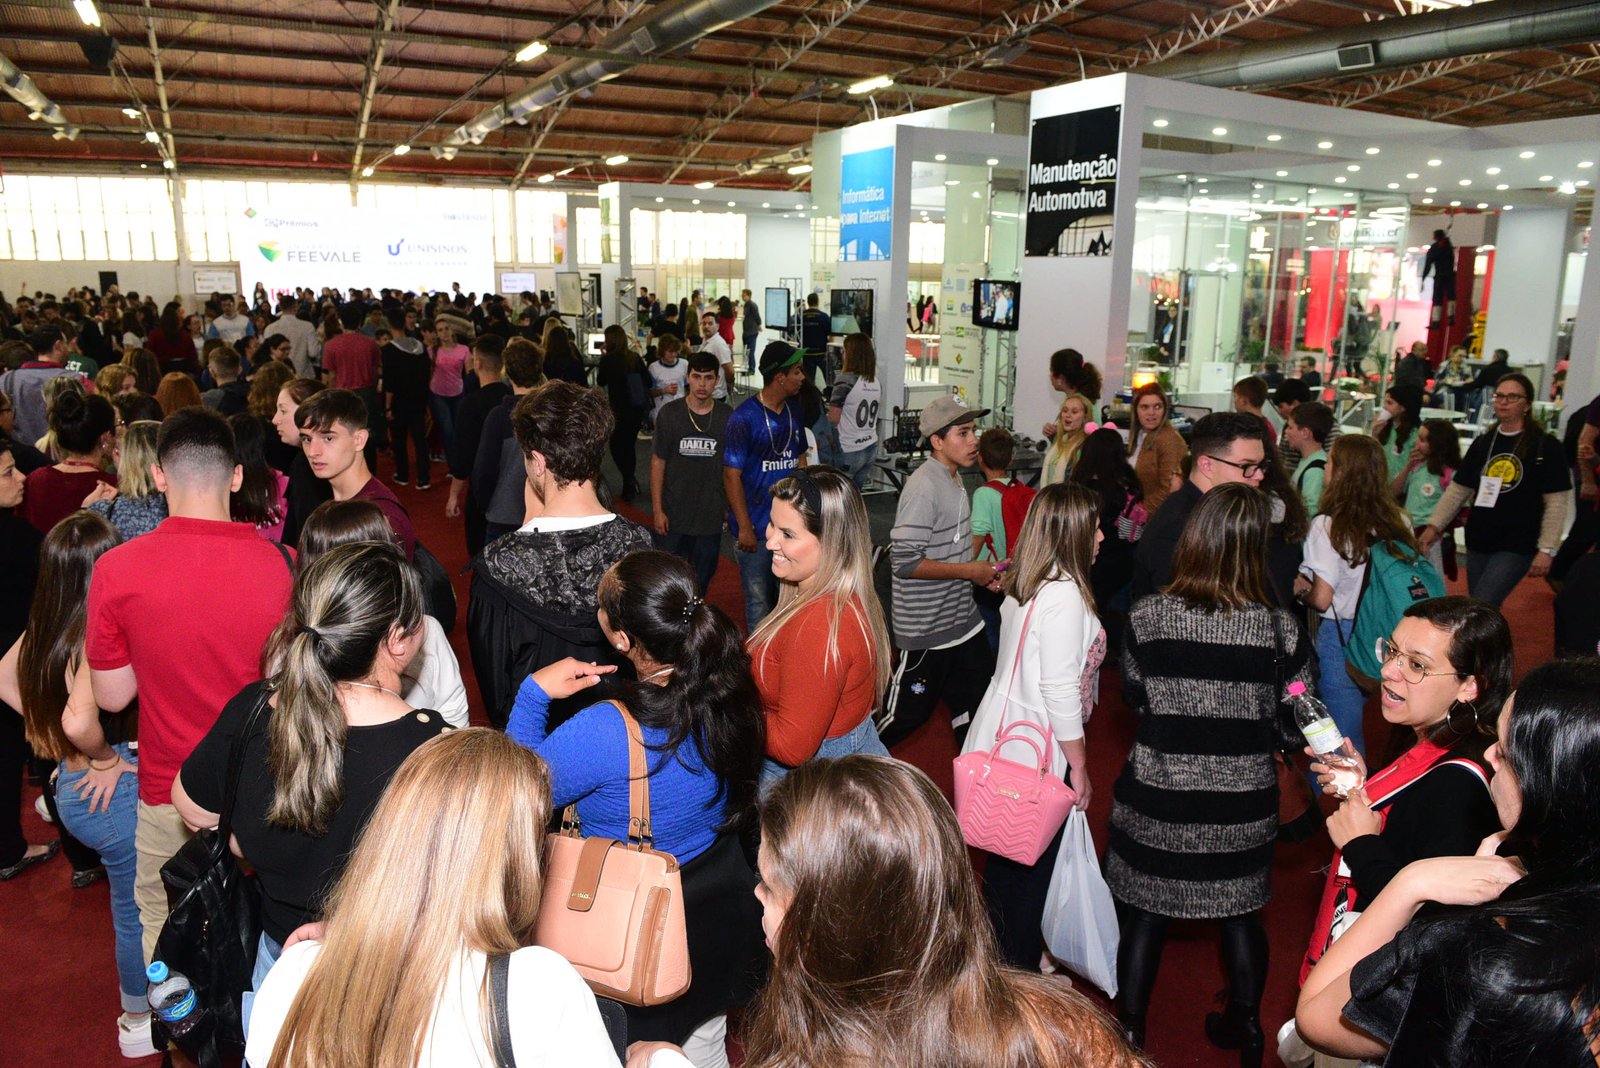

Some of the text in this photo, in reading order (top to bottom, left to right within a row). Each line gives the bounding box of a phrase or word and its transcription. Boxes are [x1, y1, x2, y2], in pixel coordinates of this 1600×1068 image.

[1030, 153, 1117, 185] Manutenção
[842, 185, 885, 204] Informática
[1028, 187, 1107, 213] Automotiva
[859, 207, 890, 224] Internet
[287, 250, 362, 264] FEEVALE
[406, 243, 469, 254] UNISINOS
[855, 399, 879, 428] 09
[679, 439, 718, 451] OAKLEY
